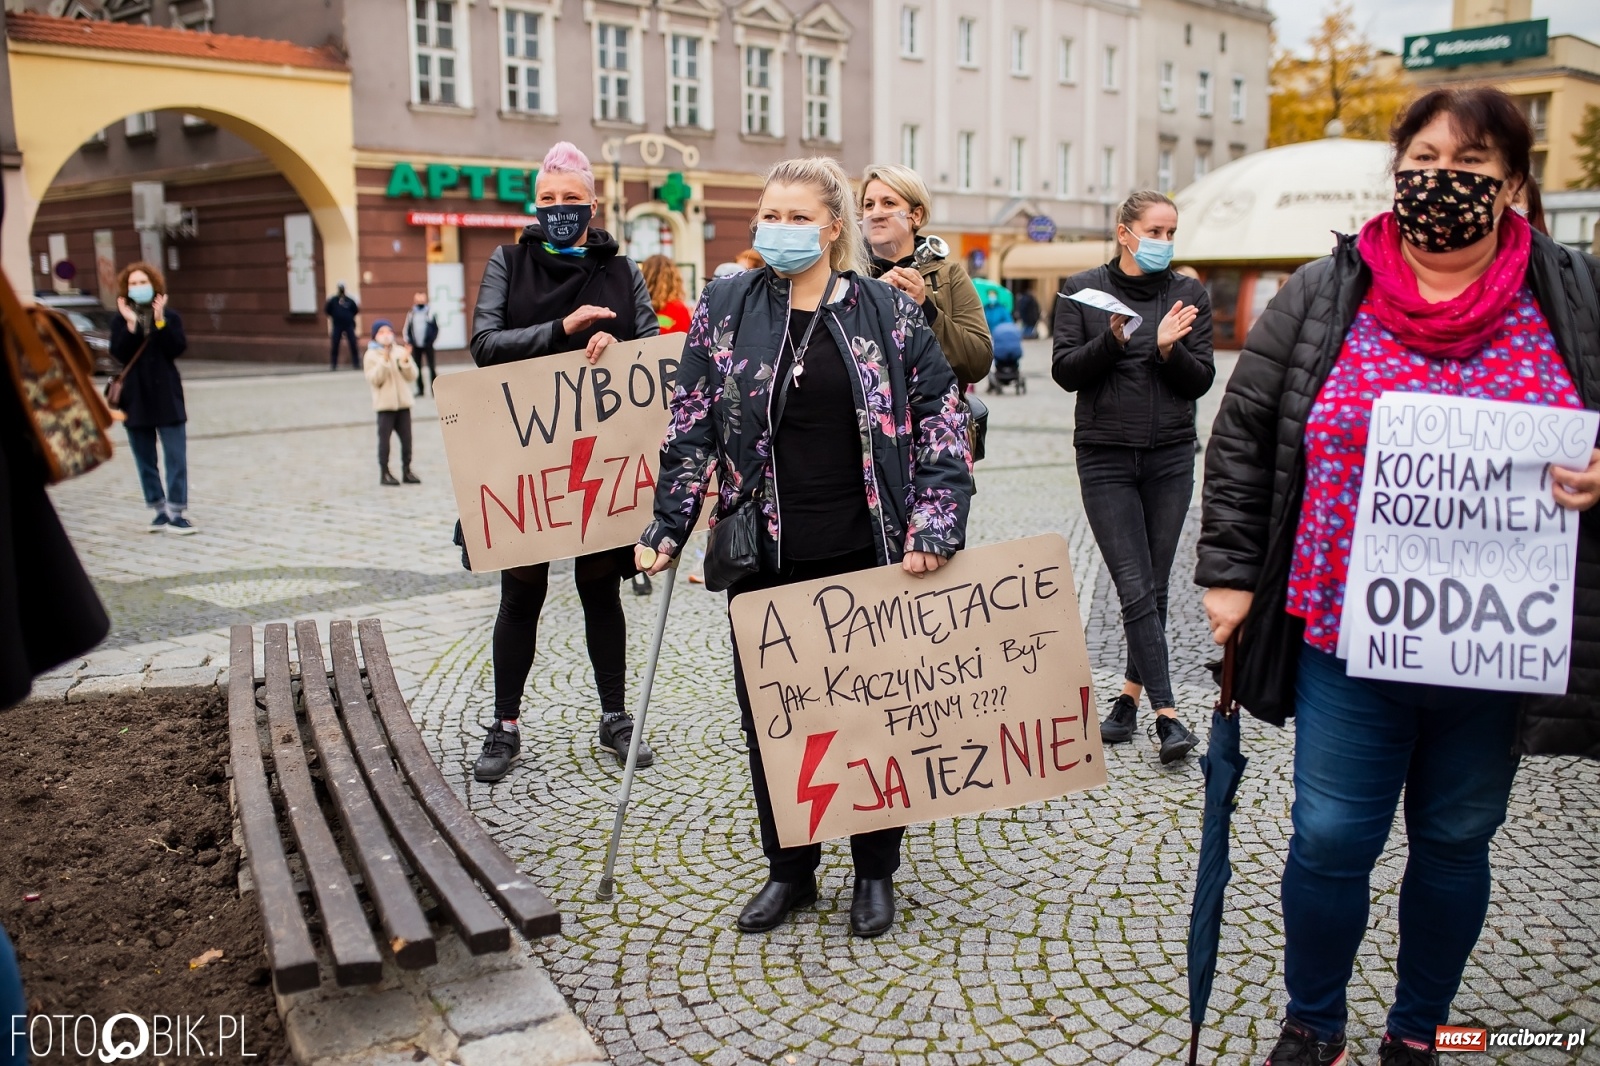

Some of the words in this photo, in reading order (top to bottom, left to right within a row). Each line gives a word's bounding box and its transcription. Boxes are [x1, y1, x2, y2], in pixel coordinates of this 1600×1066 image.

[1434, 34, 1512, 57] McDonald's
[386, 161, 541, 202] APTE
[1374, 450, 1514, 493] KOCHAM
[480, 464, 573, 550] NIE
[1372, 491, 1567, 534] ROZUMIEM
[1364, 534, 1570, 584] WOLNOŚCI
[1365, 577, 1561, 637] ODDAĆ
[758, 599, 798, 669] A
[1368, 631, 1424, 670] NIE
[1450, 638, 1567, 682] UMIEM
[758, 680, 821, 740] JAK
[883, 694, 963, 739] FAJNY
[846, 755, 911, 812] JA
[910, 738, 994, 800] TEŻ
[999, 686, 1093, 786] NIE!
